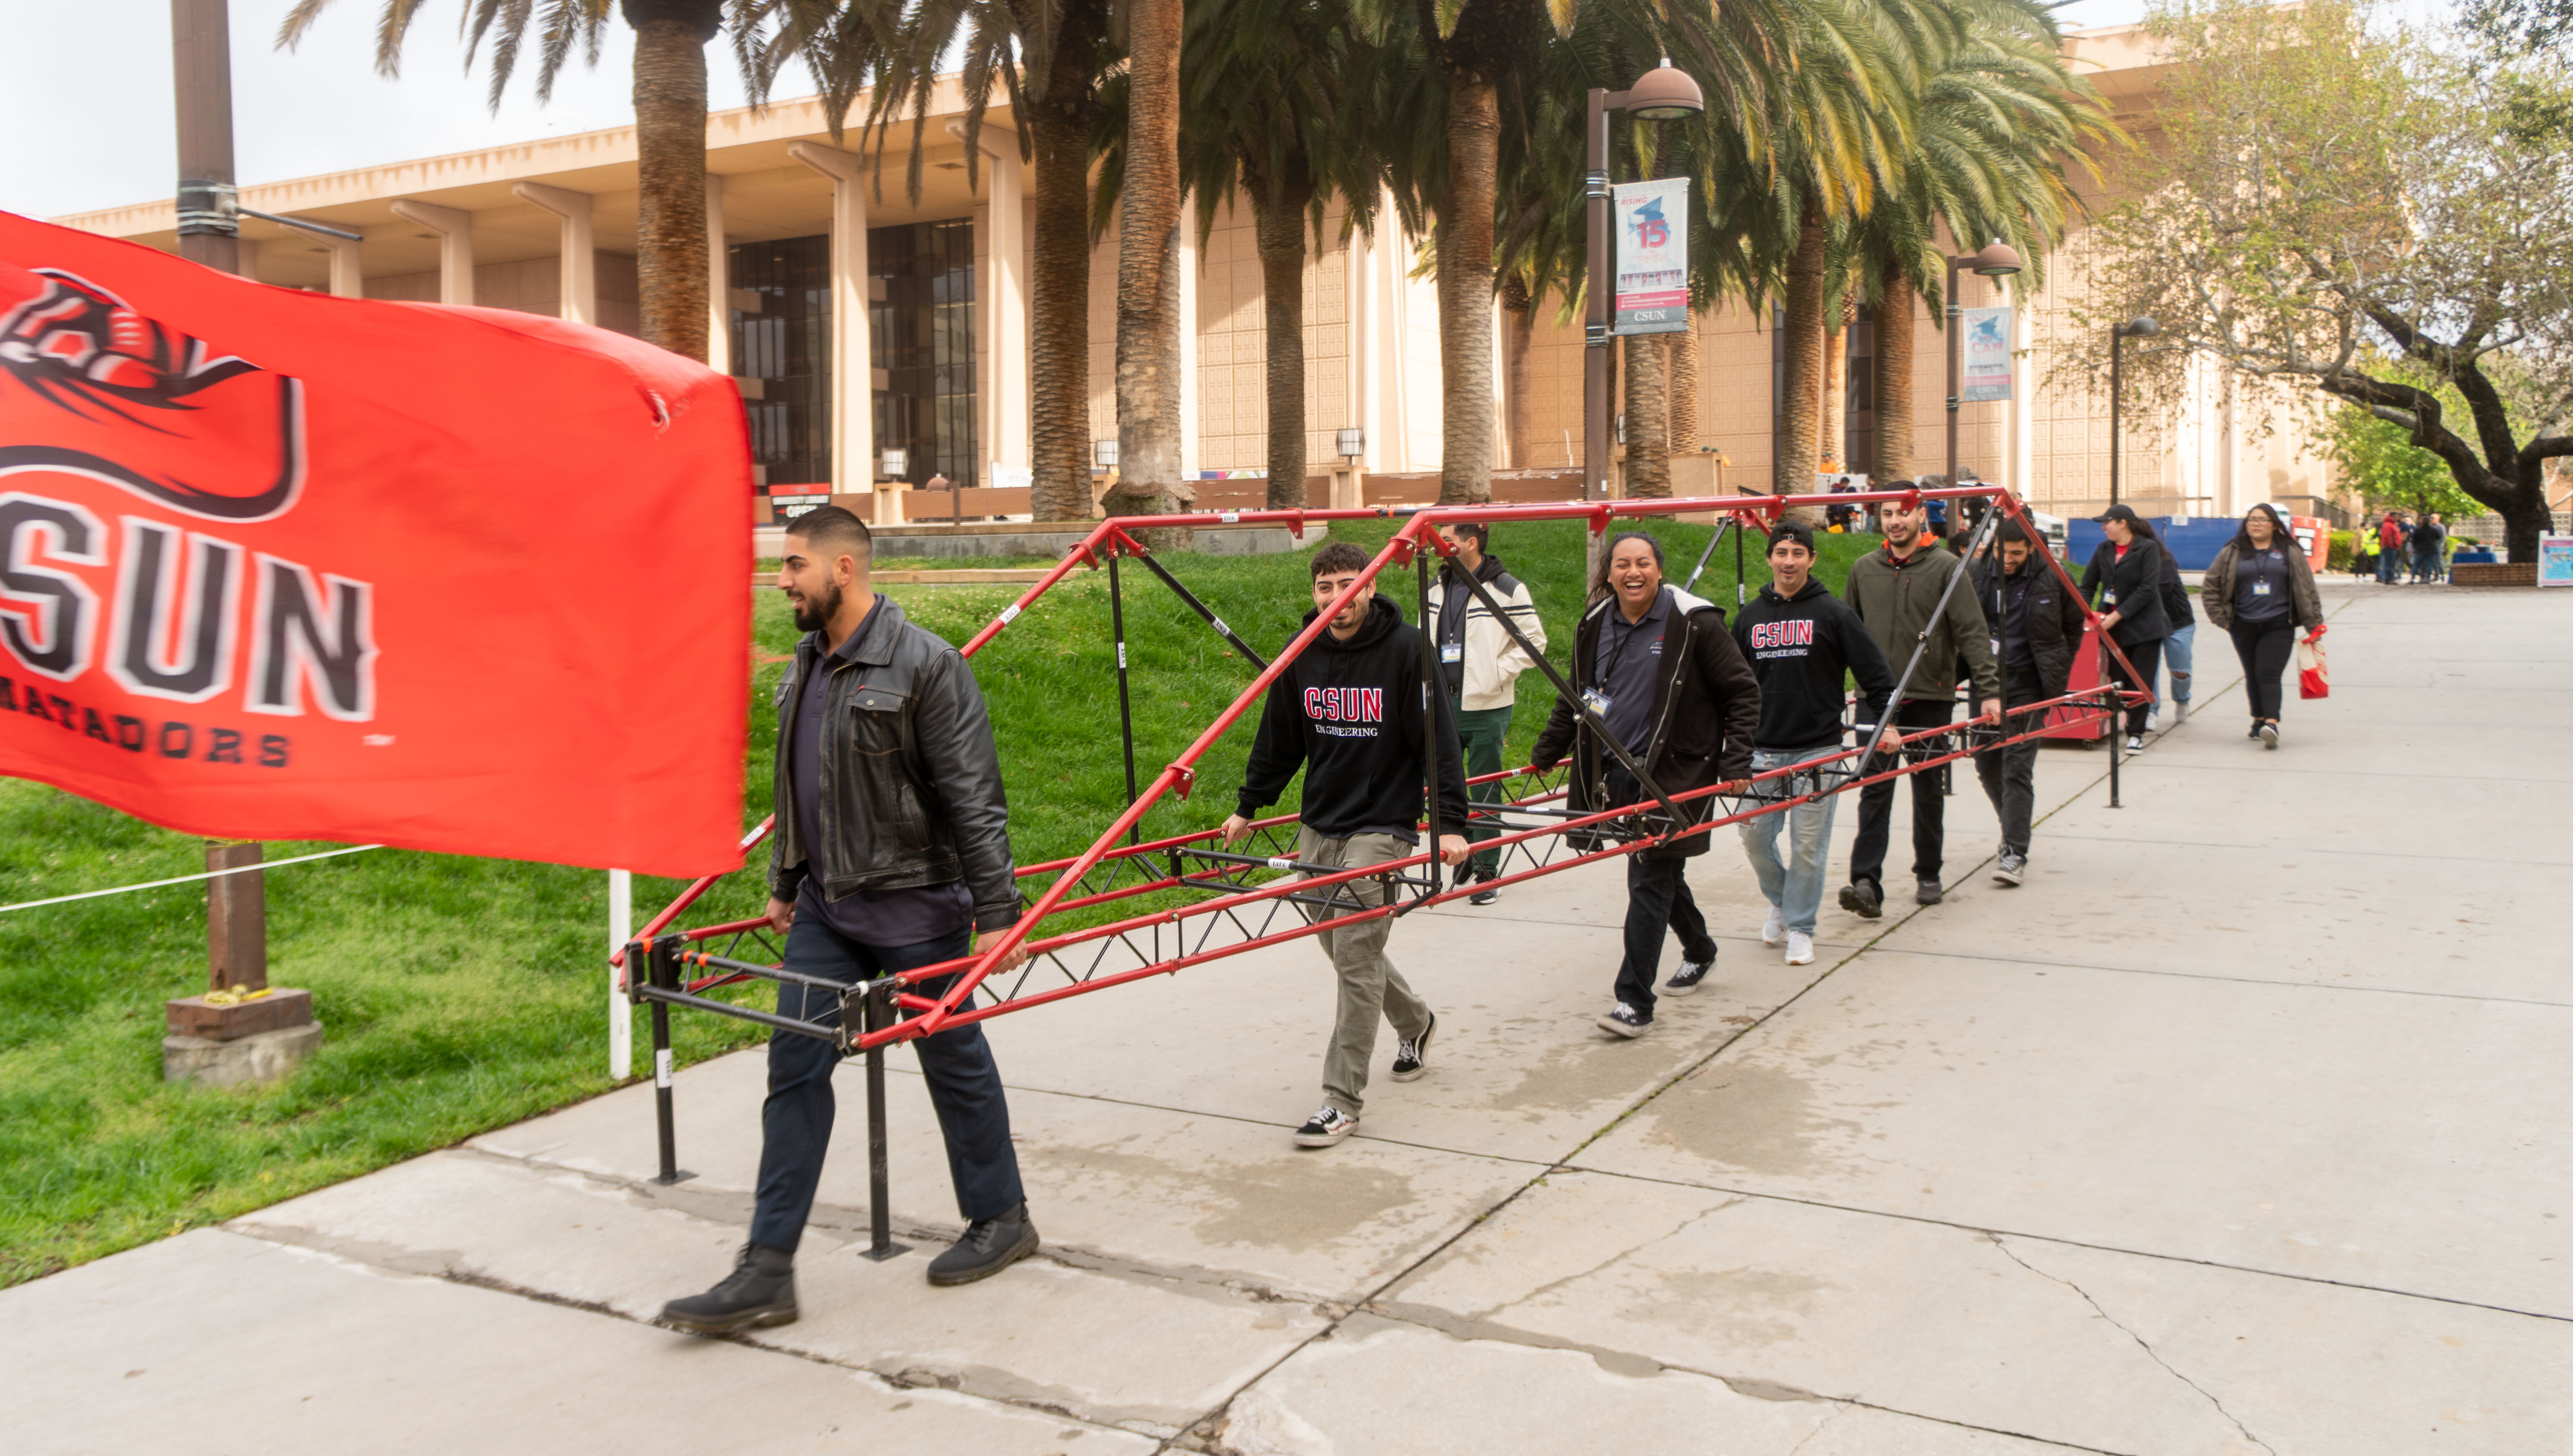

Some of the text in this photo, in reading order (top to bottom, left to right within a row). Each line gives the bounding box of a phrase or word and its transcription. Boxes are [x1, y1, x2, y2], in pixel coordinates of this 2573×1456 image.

[1621, 197, 1647, 205] RISING
[1636, 220, 1667, 249] 15
[1634, 310, 1666, 321] CSUN
[1972, 341, 2003, 354] CAN
[1751, 620, 1813, 649] CSUN
[1756, 649, 1808, 659] ENGINEERING
[1304, 687, 1382, 722] CSUN
[1315, 725, 1378, 737] ENGINEERING
